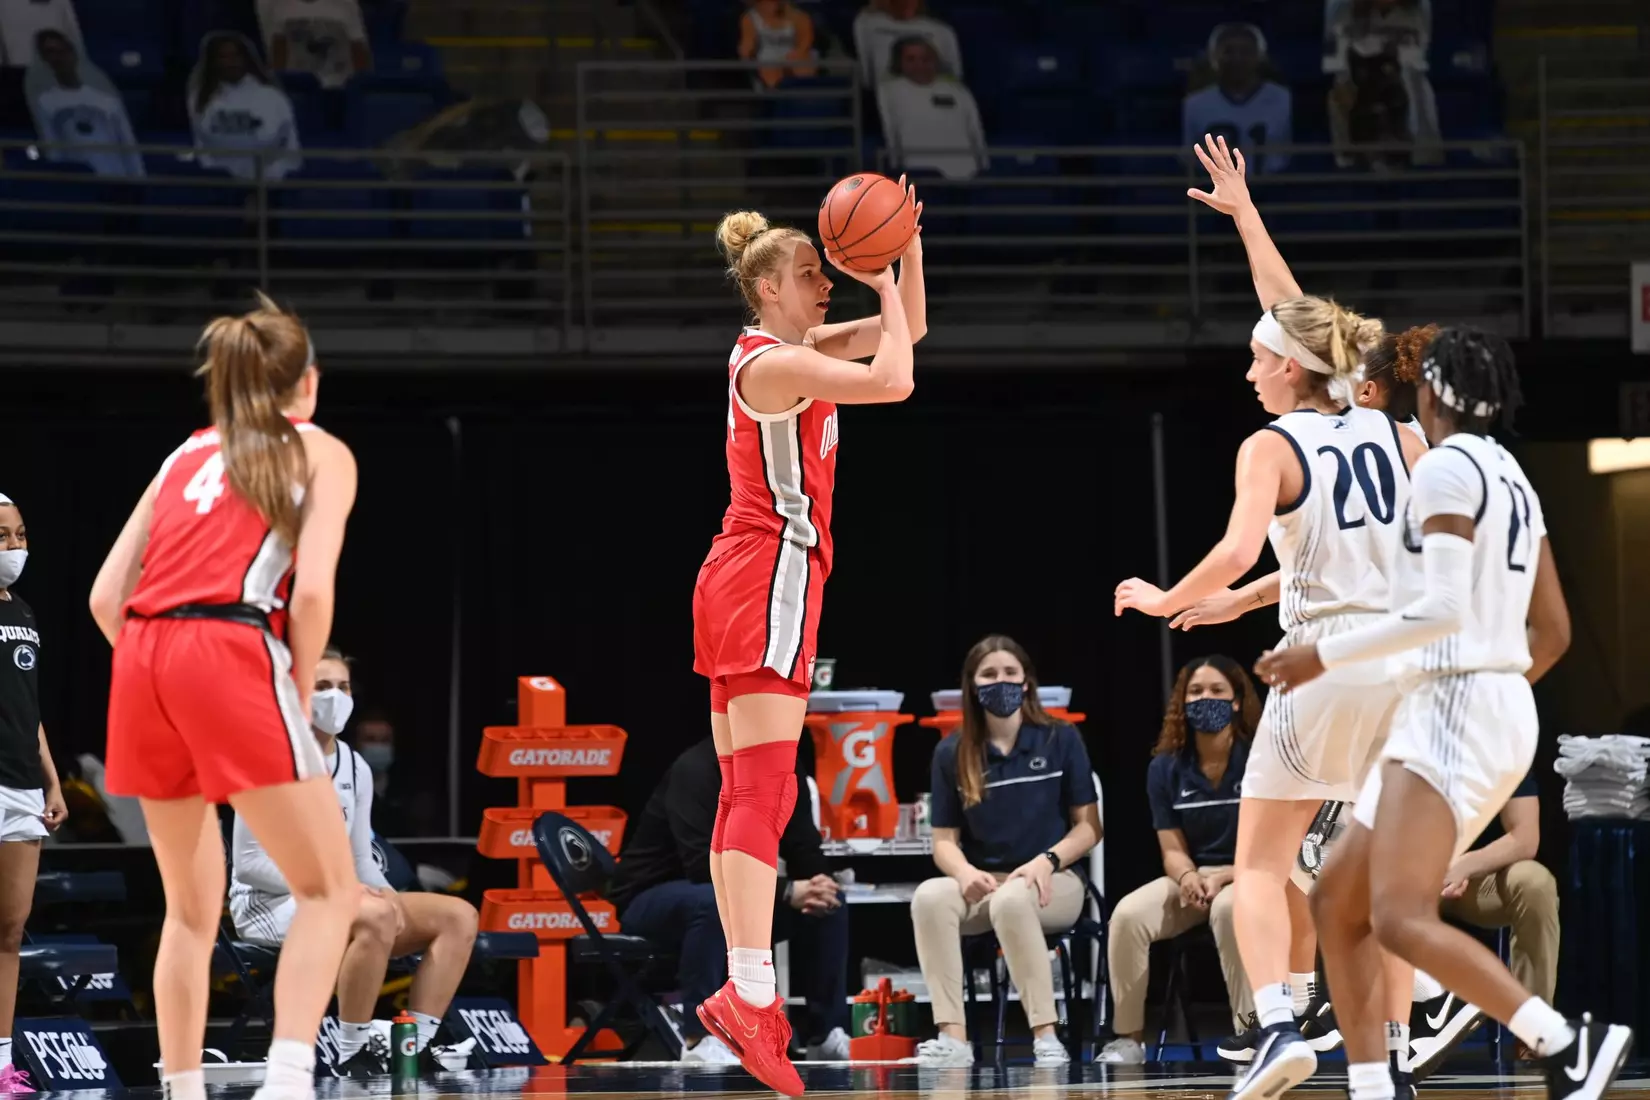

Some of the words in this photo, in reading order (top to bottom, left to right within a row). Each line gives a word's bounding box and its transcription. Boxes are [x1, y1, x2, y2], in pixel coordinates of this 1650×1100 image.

[183, 451, 225, 515] 4
[1317, 441, 1396, 530] 20
[509, 748, 611, 766] GATORADE
[842, 730, 876, 768] G
